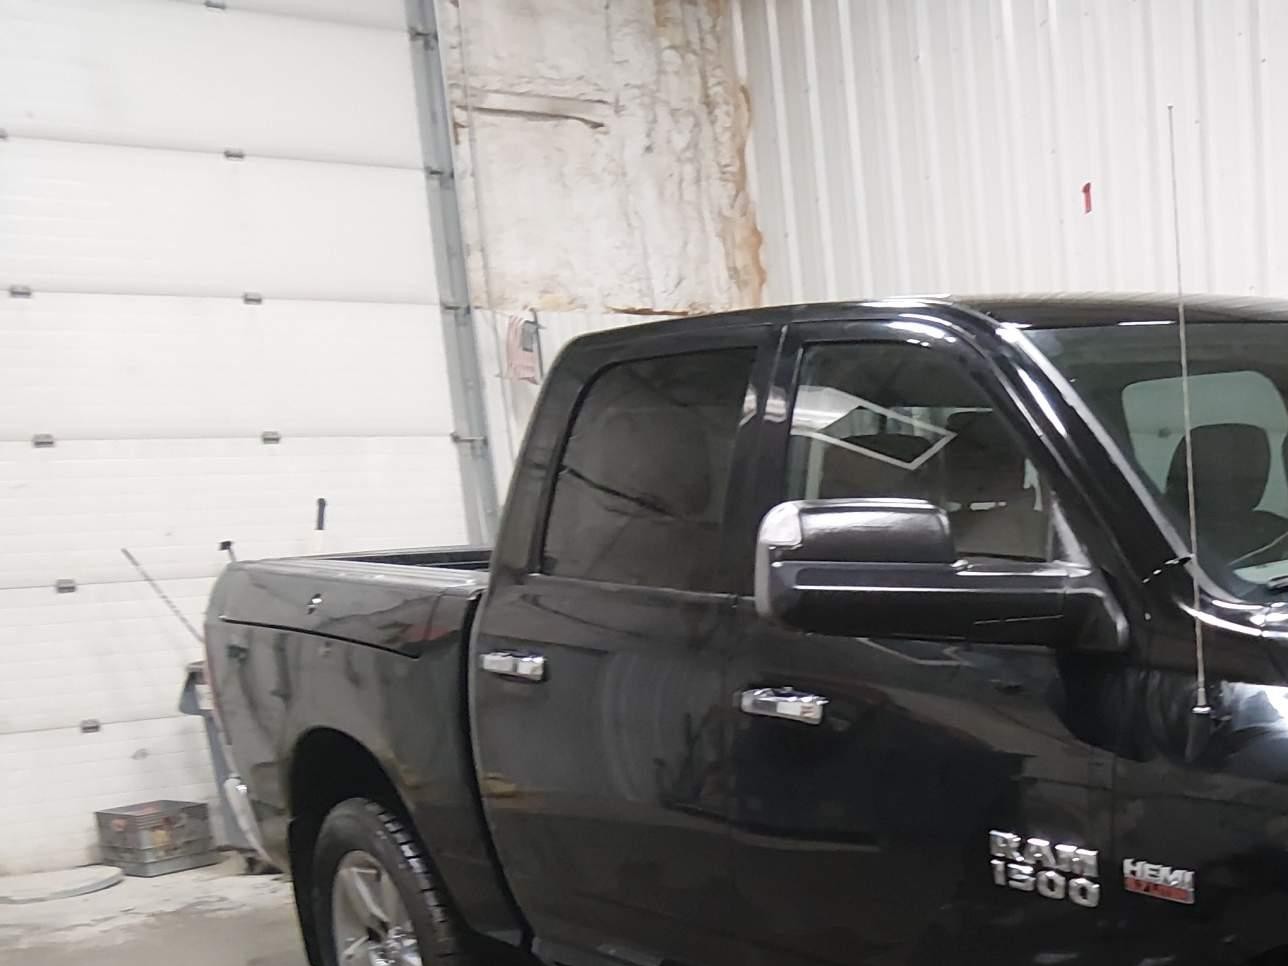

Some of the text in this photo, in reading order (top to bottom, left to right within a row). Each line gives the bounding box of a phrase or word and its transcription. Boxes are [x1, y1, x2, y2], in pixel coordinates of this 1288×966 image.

[989, 829, 1099, 878] RAM
[1122, 858, 1195, 891] HEMI
[990, 859, 1100, 908] 1500
